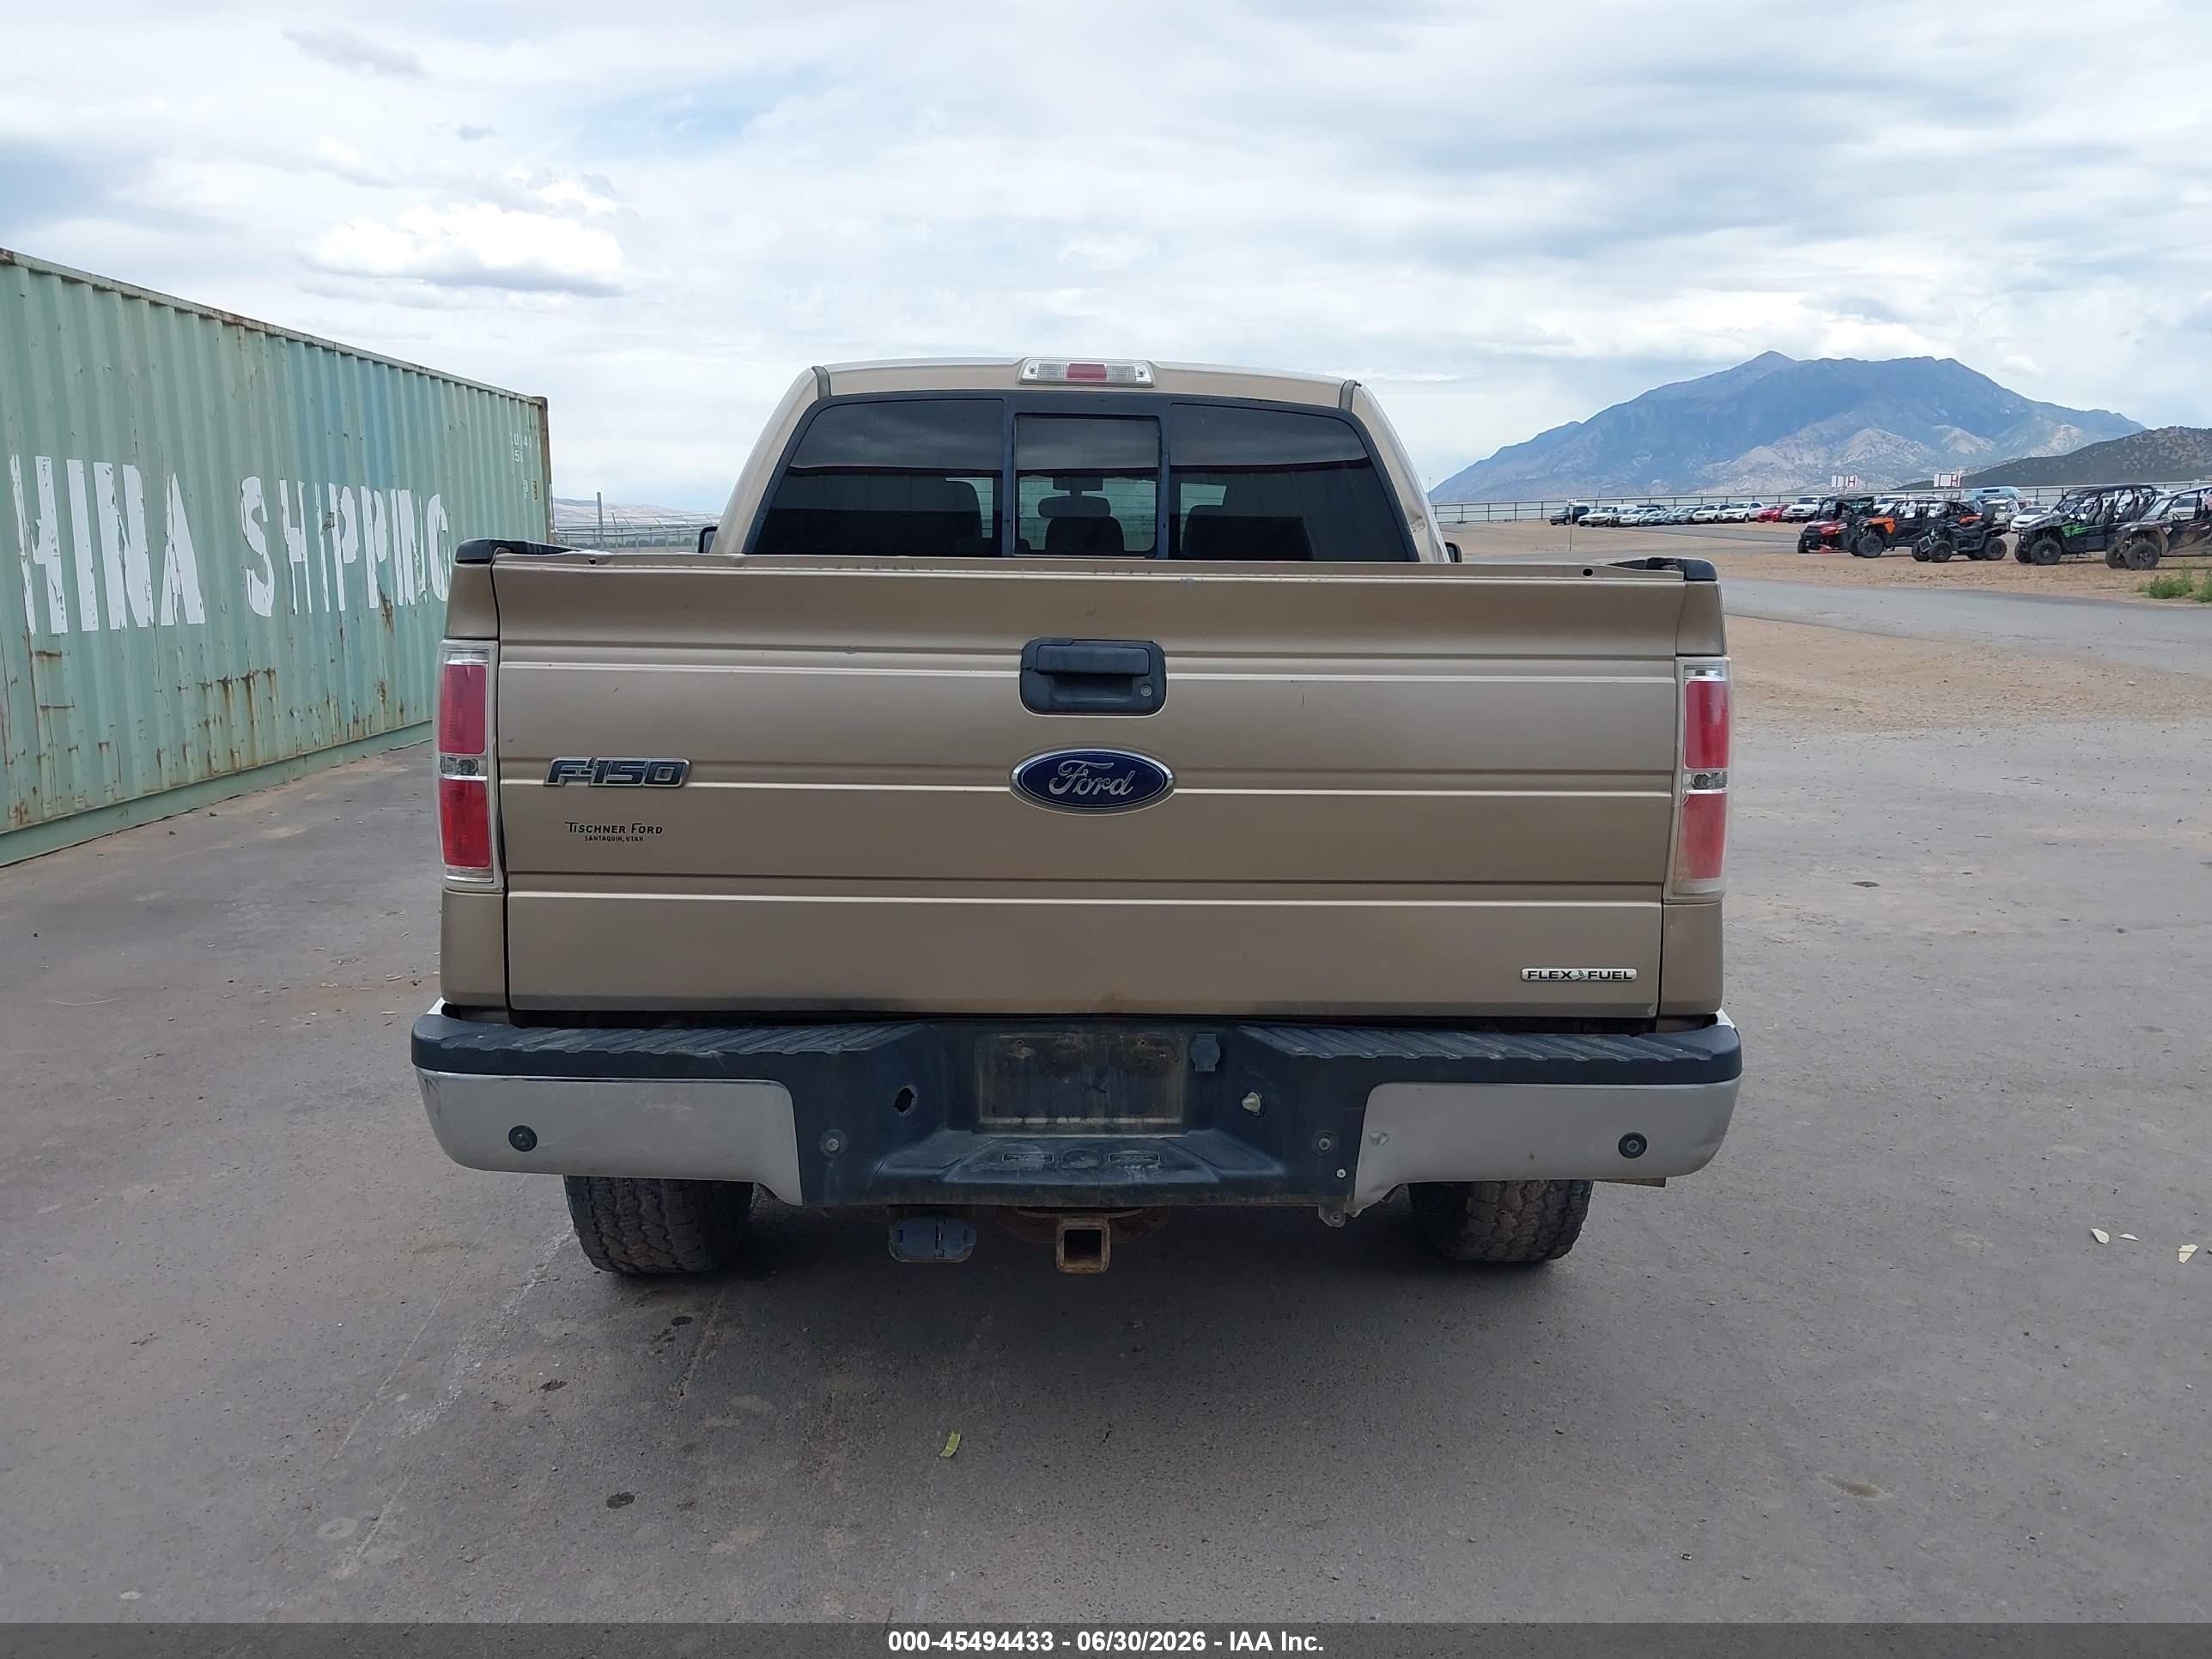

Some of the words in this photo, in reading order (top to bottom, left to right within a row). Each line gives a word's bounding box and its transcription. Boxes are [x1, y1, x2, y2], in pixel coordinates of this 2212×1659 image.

[544, 756, 691, 787] F-150
[1048, 760, 1136, 796] Ford
[1527, 970, 1573, 980] FLEX
[1588, 970, 1633, 980] FUEL
